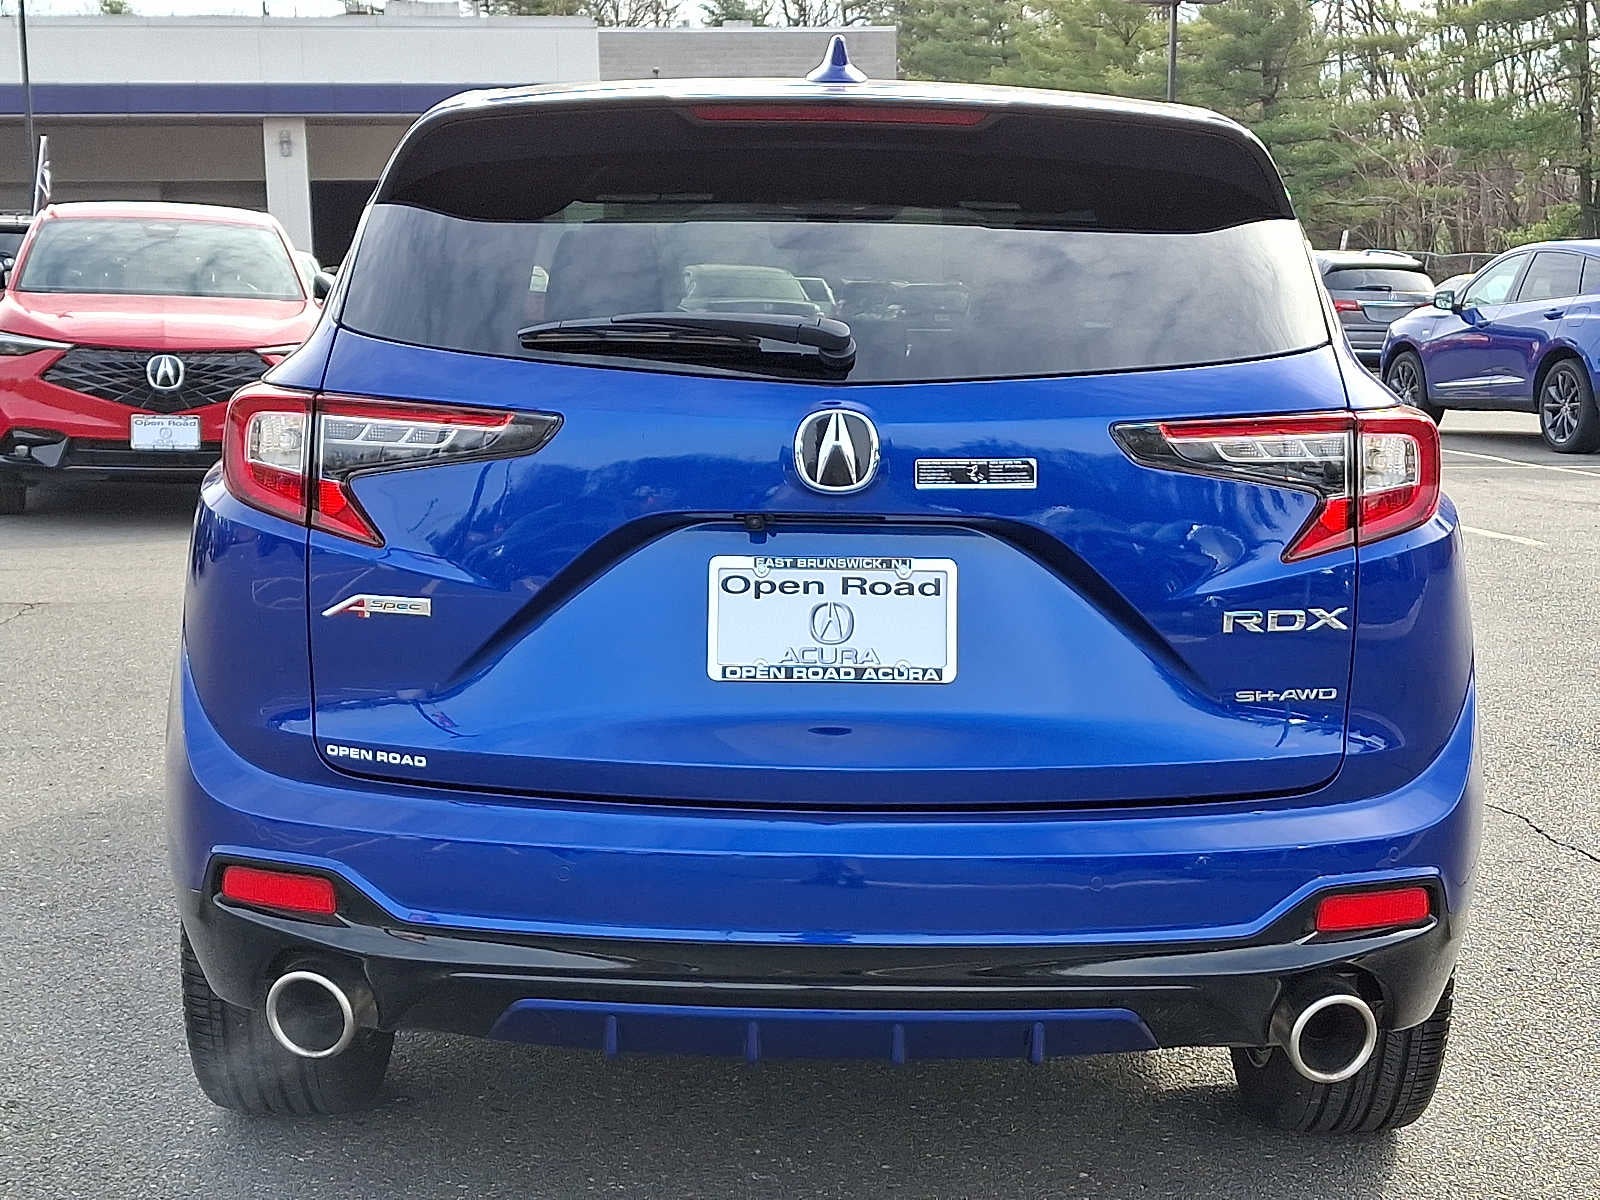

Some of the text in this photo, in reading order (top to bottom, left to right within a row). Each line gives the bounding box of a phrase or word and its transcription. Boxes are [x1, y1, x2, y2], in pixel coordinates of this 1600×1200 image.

[756, 557, 794, 568] EAST
[721, 575, 941, 599] Open Road
[1223, 607, 1348, 633] RDX
[780, 647, 880, 665] ACURA
[725, 667, 941, 681] OPEN ROAD ACURA
[1235, 688, 1338, 702] SH-AWD
[326, 744, 427, 767] OPEN ROAD
